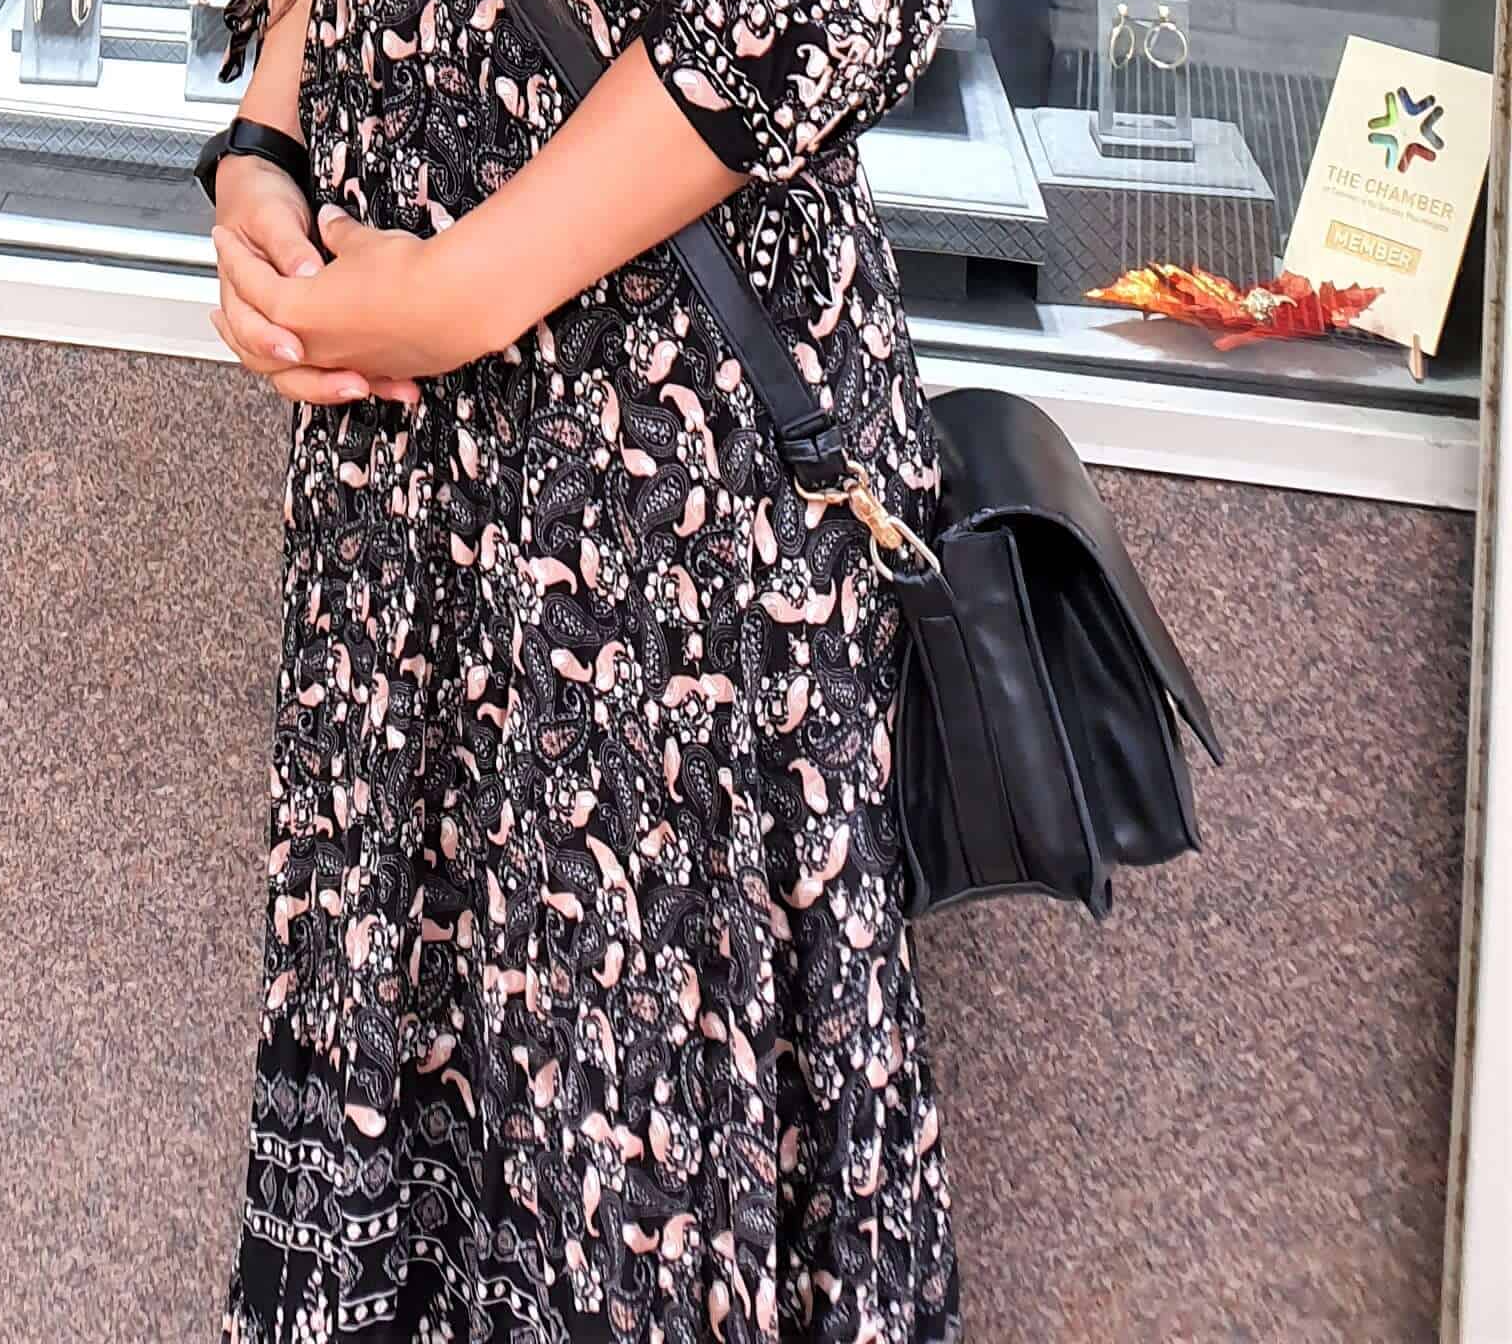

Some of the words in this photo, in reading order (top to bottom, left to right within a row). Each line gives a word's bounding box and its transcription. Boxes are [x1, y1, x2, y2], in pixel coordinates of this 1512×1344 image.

[1327, 164, 1362, 189] THE
[1364, 178, 1455, 220] CHAMBER
[1333, 229, 1414, 269] MEMBER
